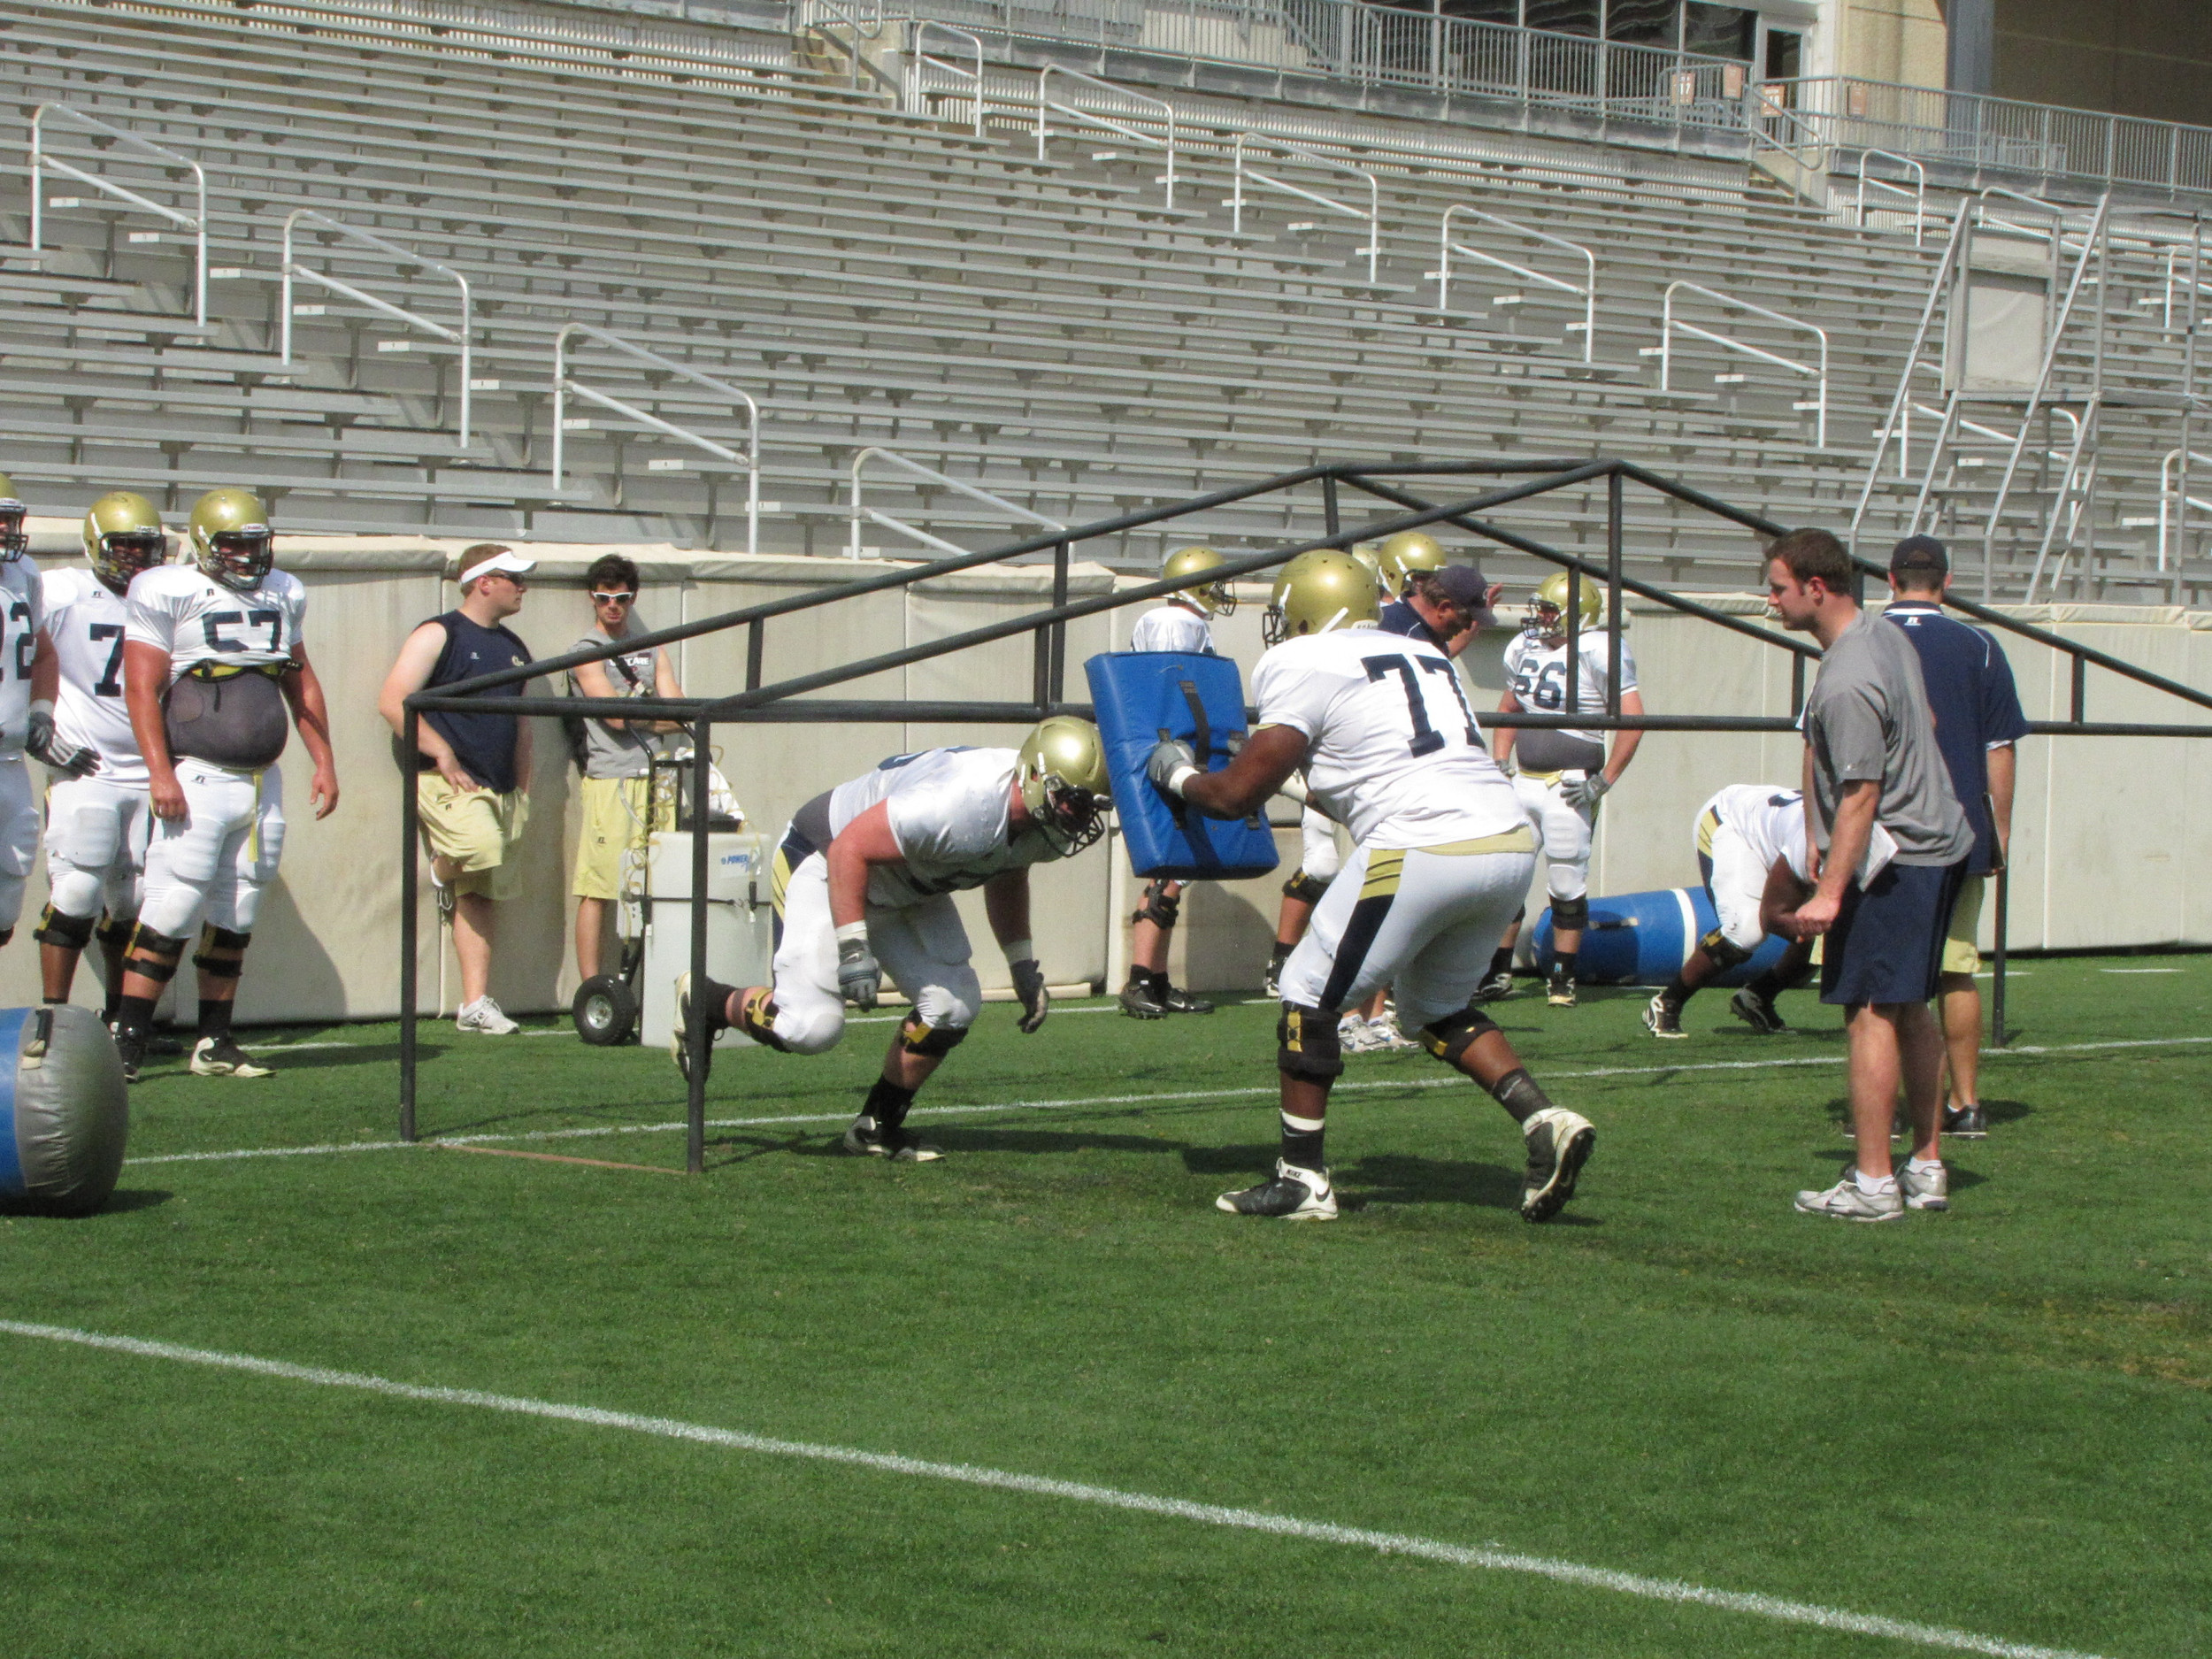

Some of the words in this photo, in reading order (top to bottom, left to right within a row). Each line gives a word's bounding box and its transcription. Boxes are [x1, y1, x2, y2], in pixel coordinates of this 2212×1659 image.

[0, 602, 35, 680] 2
[89, 623, 126, 697] 7
[1360, 653, 1487, 758] 77
[1286, 1169, 1303, 1179] NIKE
